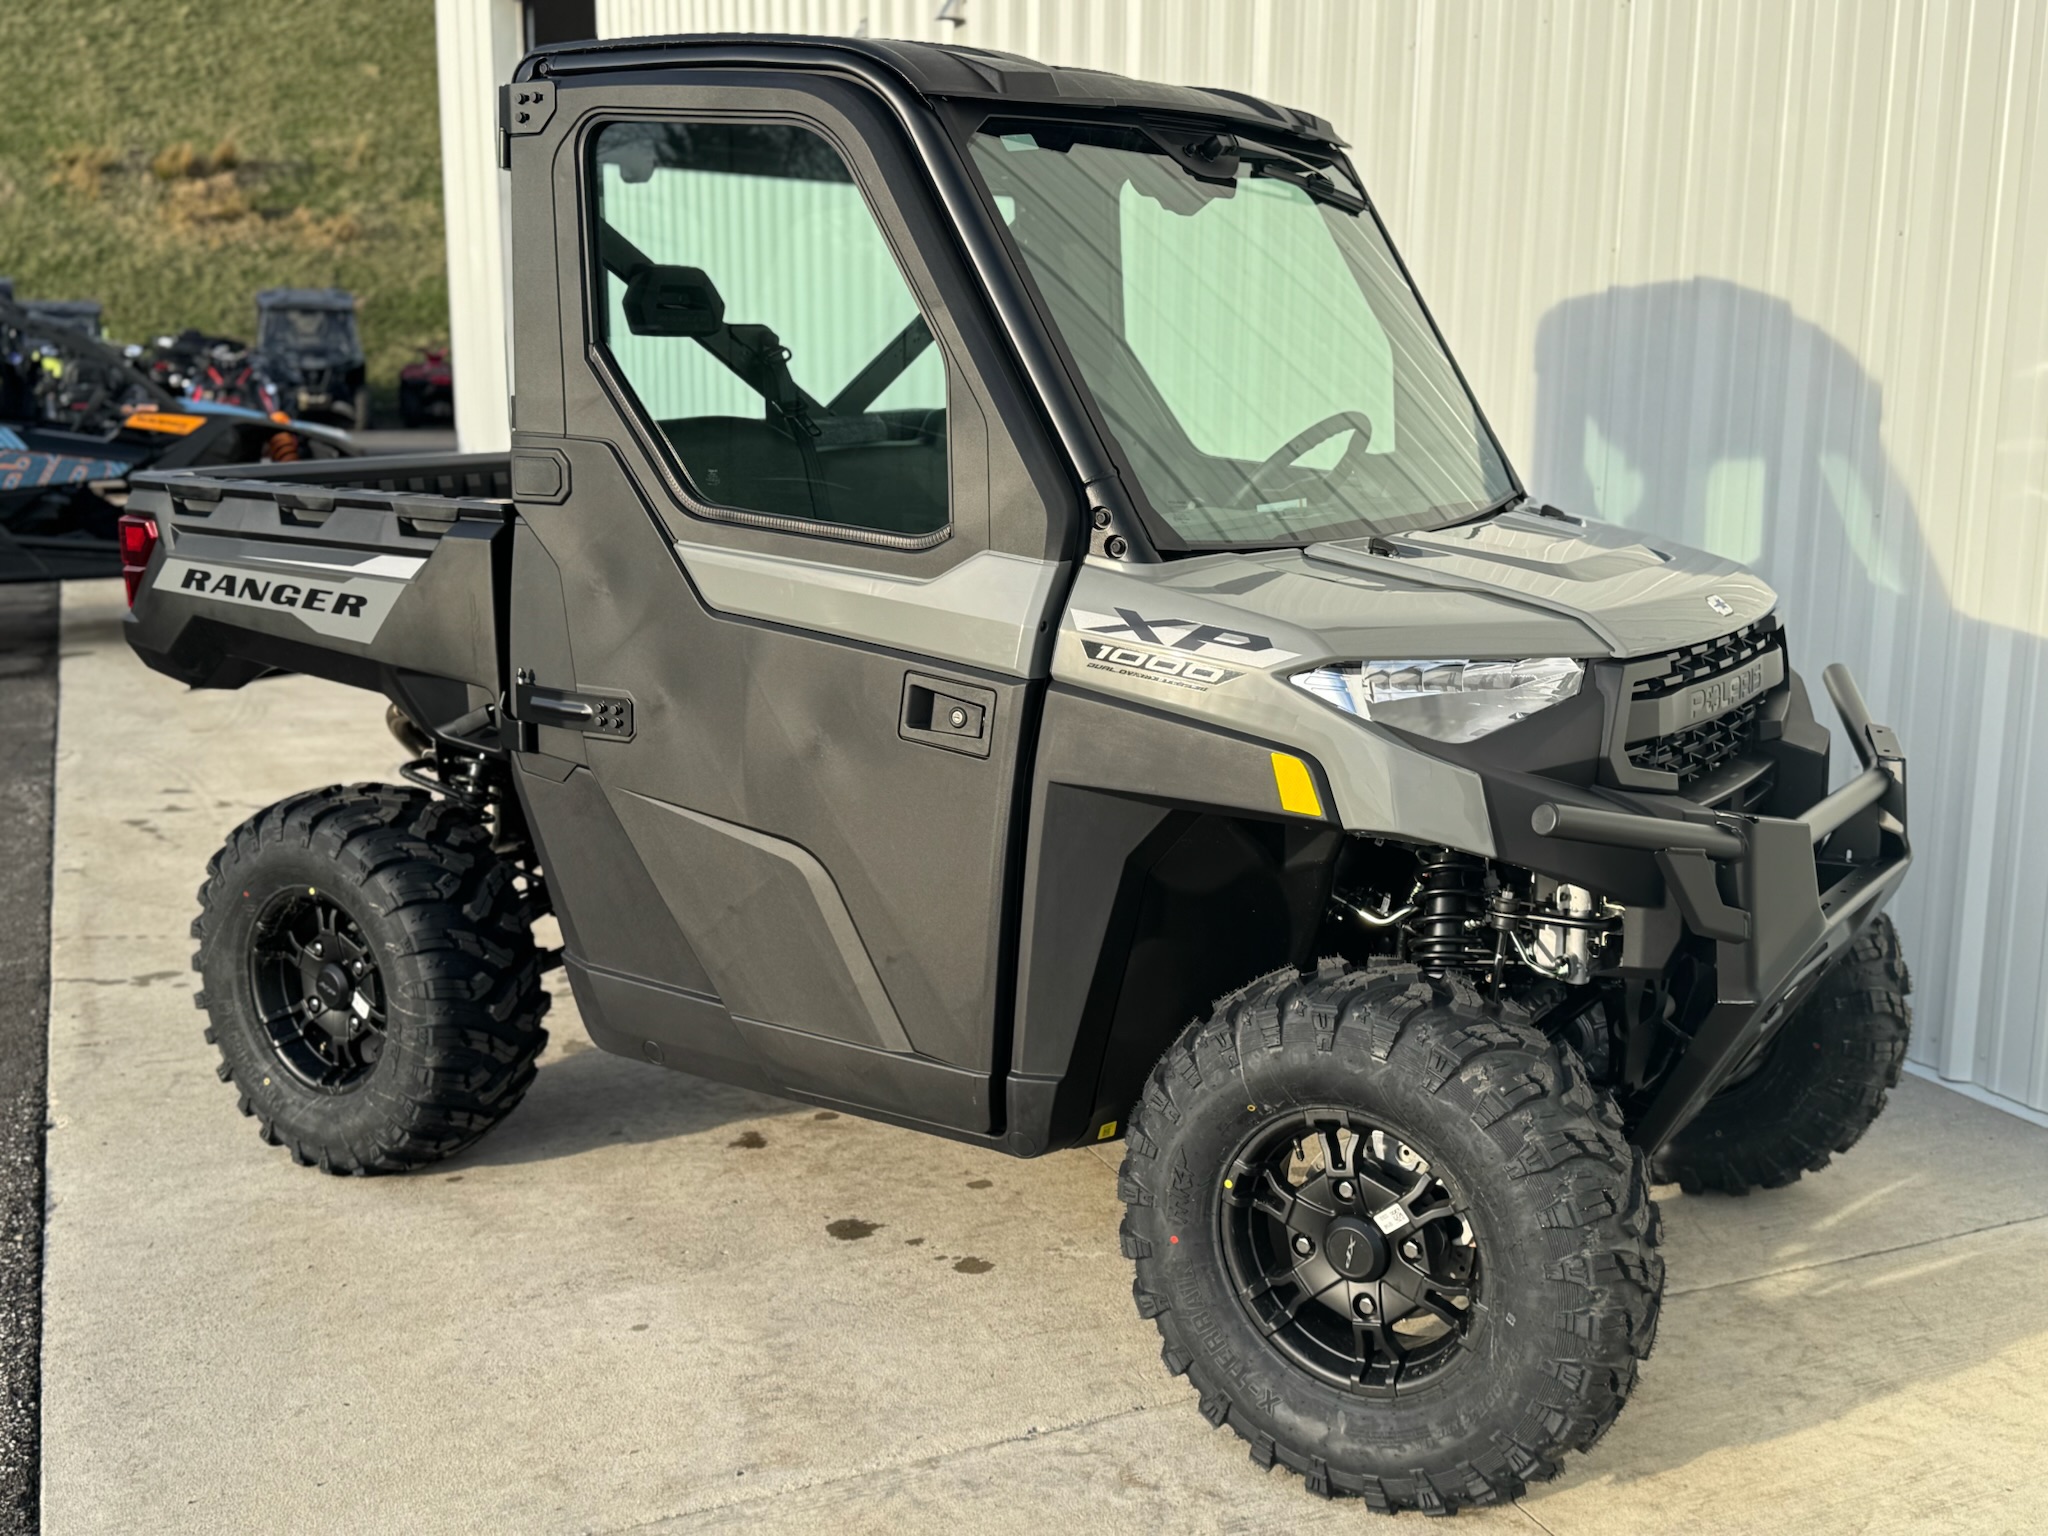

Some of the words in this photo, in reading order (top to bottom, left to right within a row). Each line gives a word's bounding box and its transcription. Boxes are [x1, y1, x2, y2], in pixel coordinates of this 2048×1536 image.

[180, 567, 368, 619] RANGER
[1085, 607, 1274, 652] XP
[1096, 644, 1225, 685] 1000
[1691, 664, 1763, 719] POLARIS
[1173, 1256, 1284, 1418] X-TERRAIN
